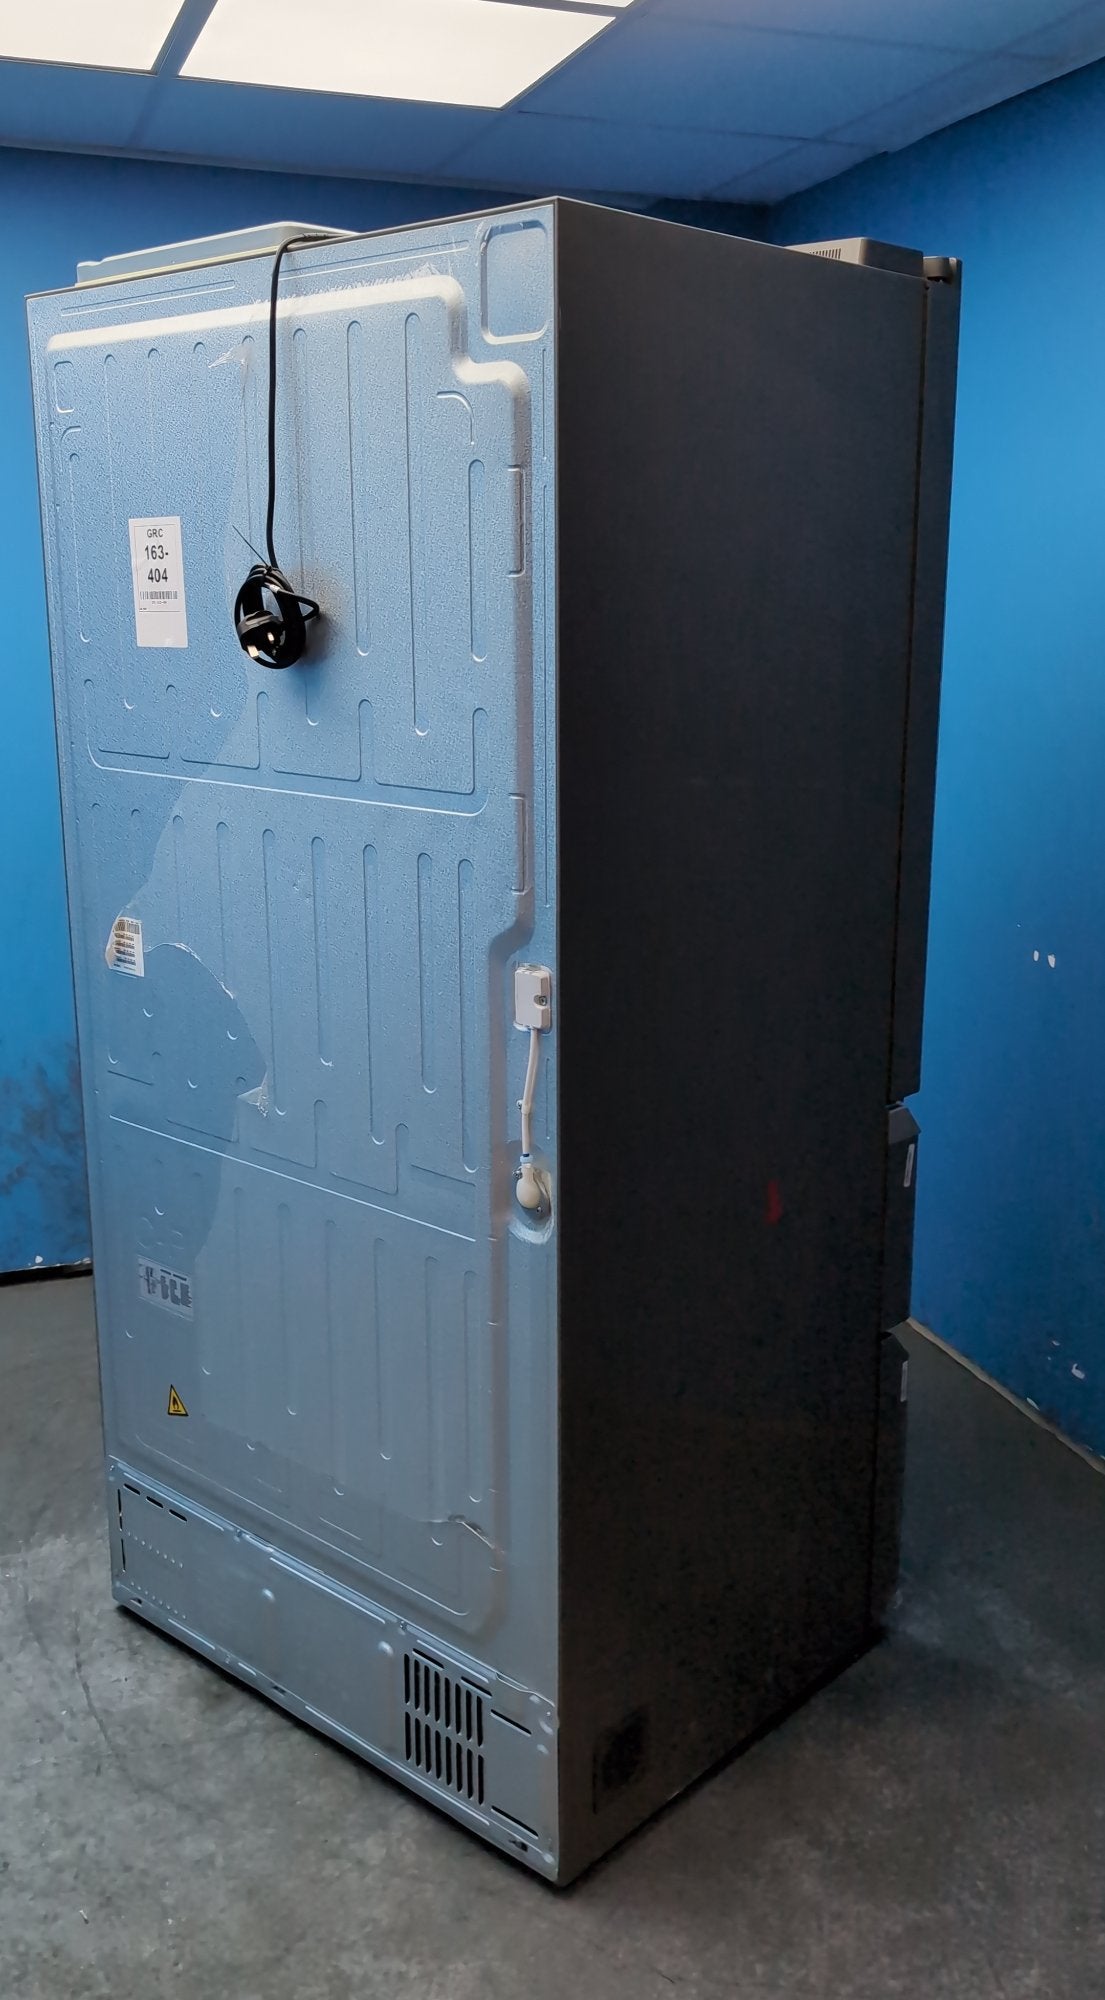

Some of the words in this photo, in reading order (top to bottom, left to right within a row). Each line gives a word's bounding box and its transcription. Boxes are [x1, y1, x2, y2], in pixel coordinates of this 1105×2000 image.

[147, 528, 164, 538] GRC
[144, 545, 169, 560] 163-
[147, 568, 168, 583] 404
